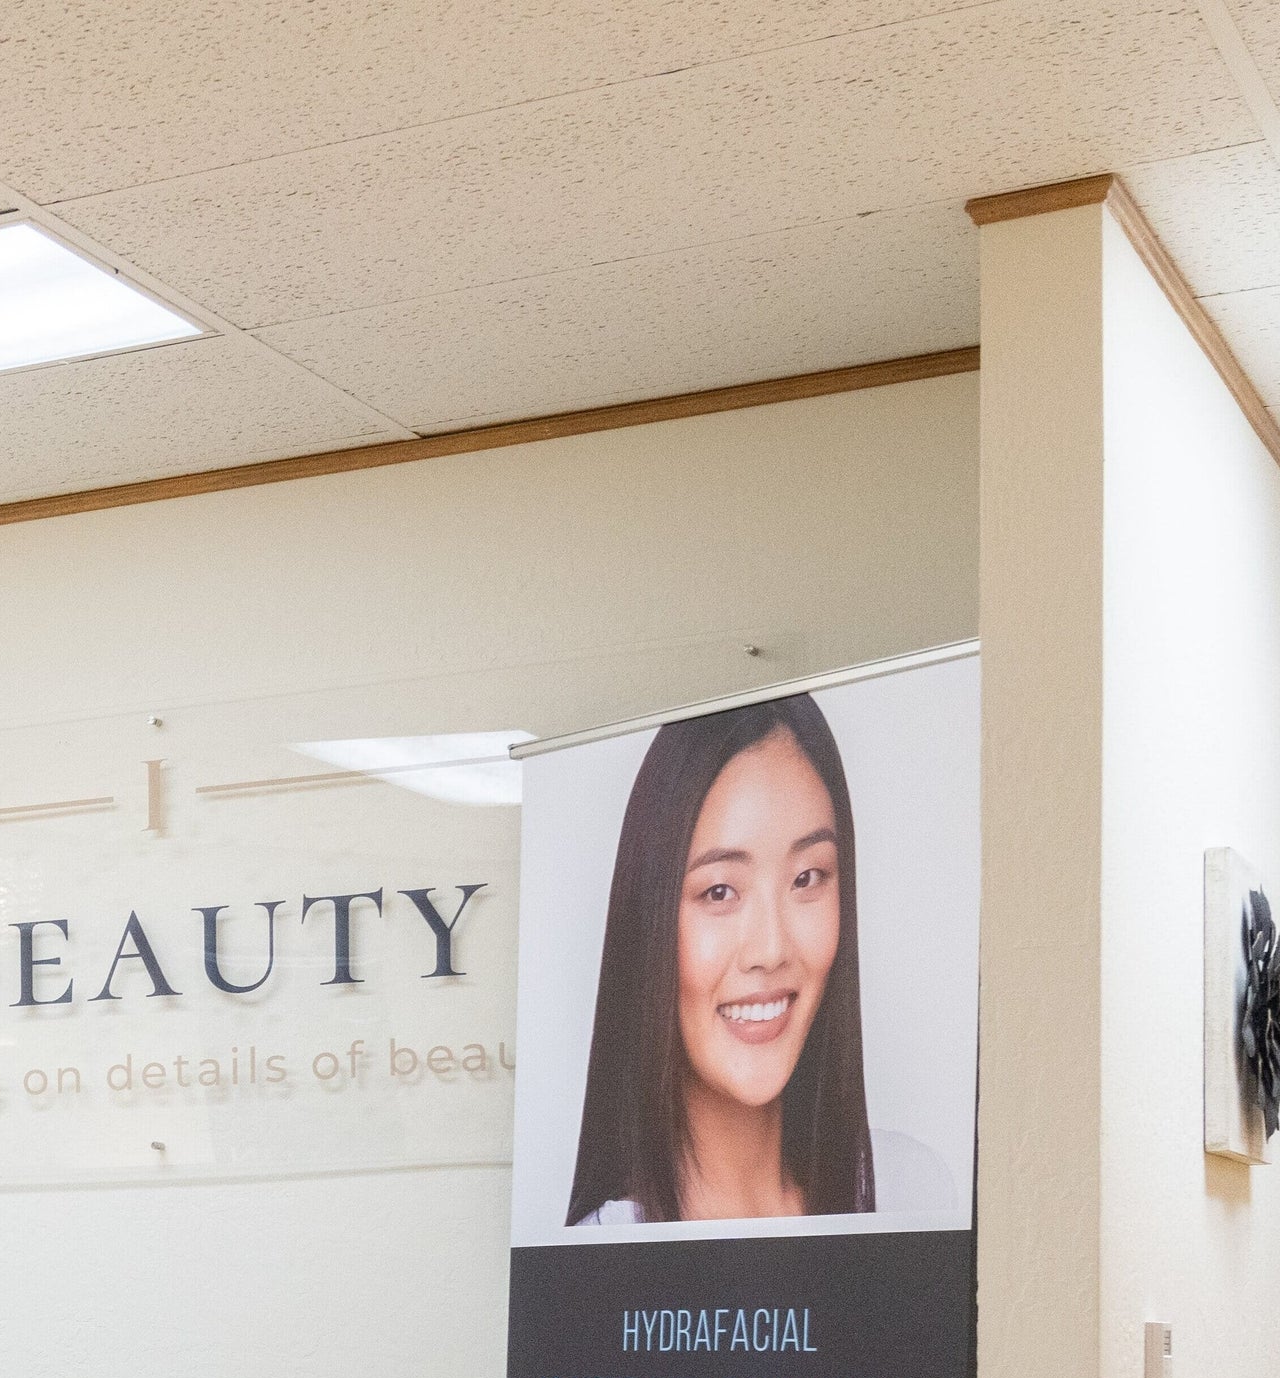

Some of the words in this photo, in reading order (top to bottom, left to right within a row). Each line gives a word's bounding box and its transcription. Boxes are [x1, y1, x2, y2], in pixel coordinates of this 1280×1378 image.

[23, 1066, 81, 1095] on
[106, 1046, 288, 1092] details
[312, 1039, 365, 1080] of
[389, 1038, 515, 1077] beau
[622, 1308, 817, 1352] HYDRAFACIAL
